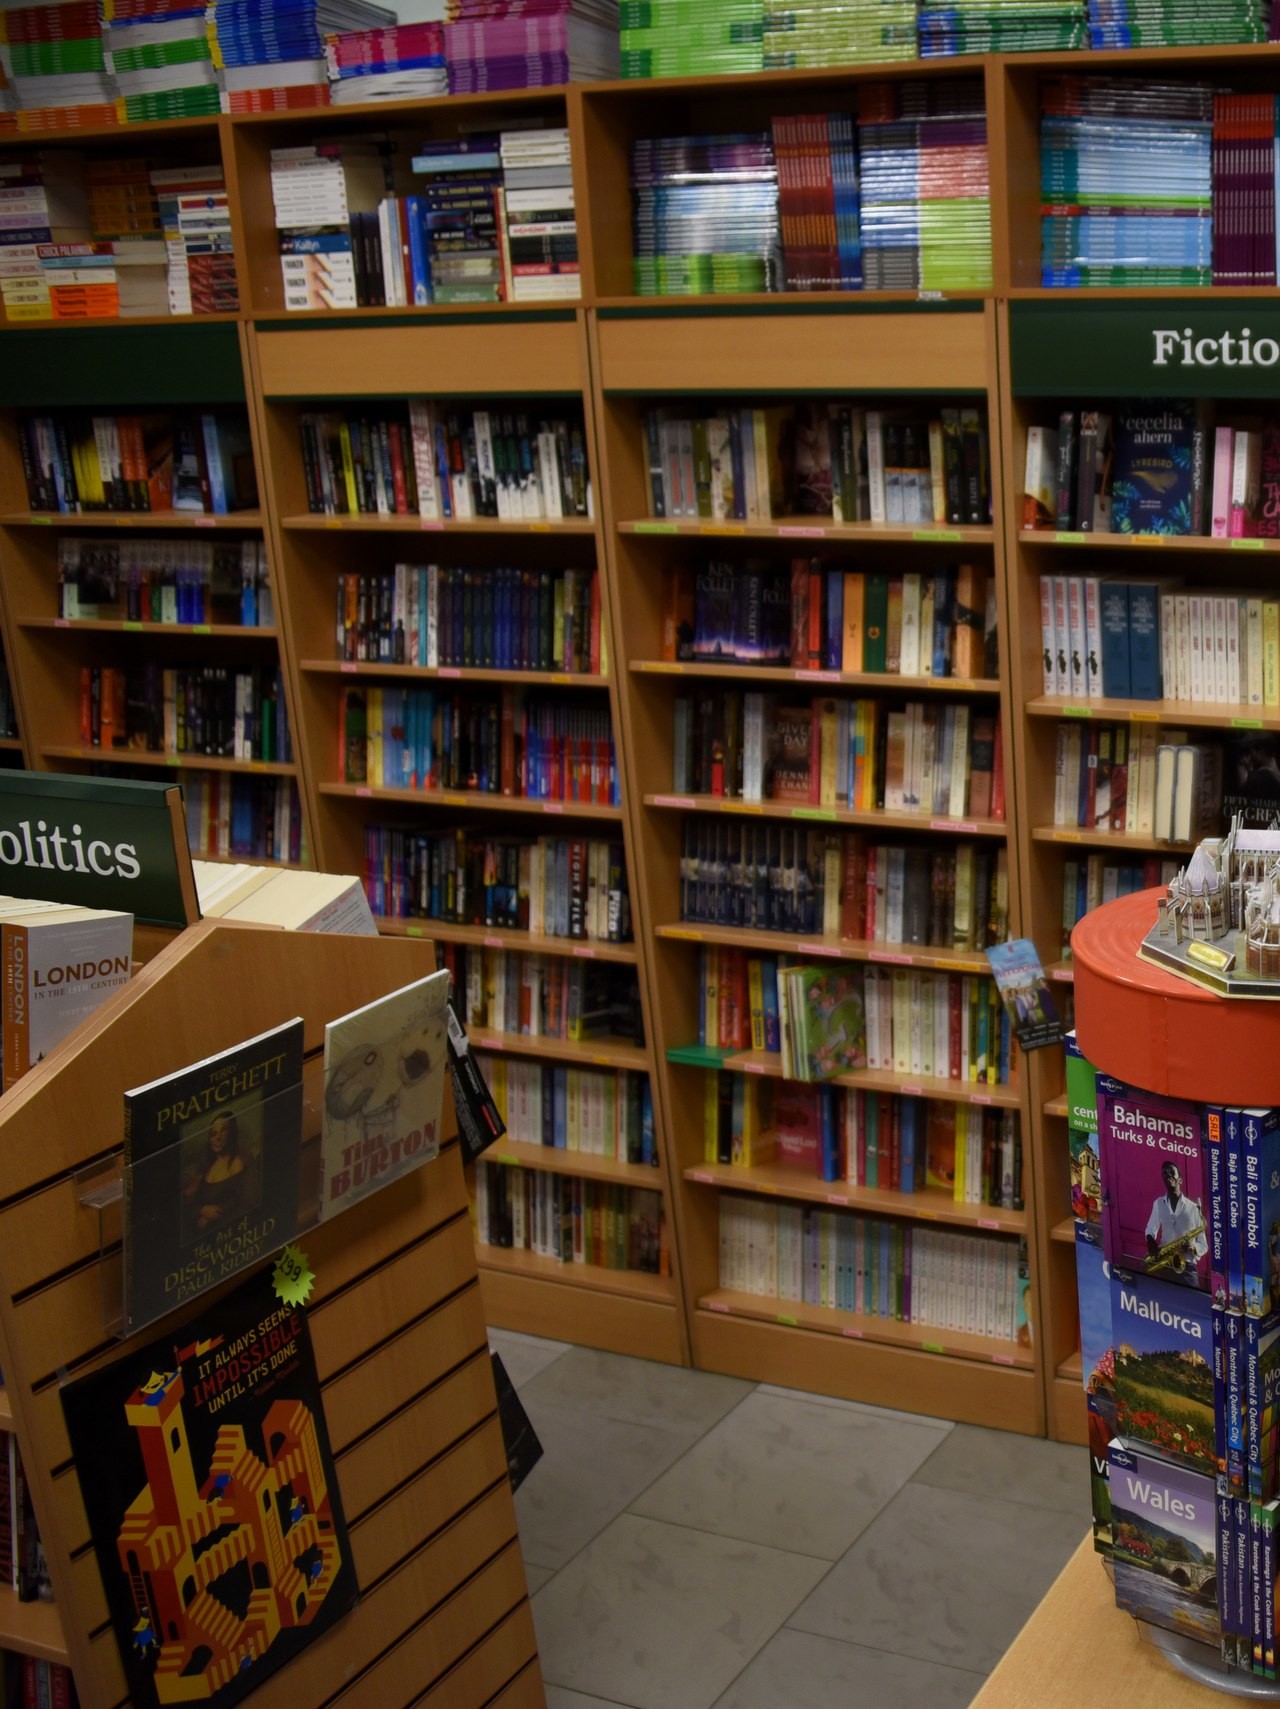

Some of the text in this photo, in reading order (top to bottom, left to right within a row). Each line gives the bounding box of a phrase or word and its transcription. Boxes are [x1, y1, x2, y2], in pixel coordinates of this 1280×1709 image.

[1126, 411, 1184, 431] cecelia
[1133, 430, 1173, 445] ahern
[783, 734, 809, 747] DAY
[13, 934, 25, 1026] LONDON
[34, 955, 130, 988] LONDON
[155, 1052, 288, 1133] PRATCHETT
[1113, 1104, 1194, 1140] Bahamas
[1208, 1115, 1220, 1142] SALE
[1110, 1125, 1143, 1145] Turks
[1158, 1136, 1199, 1158] Caicos
[329, 1118, 438, 1201] BURTON
[1210, 1148, 1220, 1193] Bahamas,
[1228, 1153, 1238, 1174] Baja
[1229, 1184, 1238, 1198] Los
[1246, 1155, 1259, 1250] Bali & Lombok
[1211, 1196, 1221, 1220] Turks
[1230, 1200, 1238, 1228] Cabos
[163, 1217, 277, 1294] DISCWORLD
[1213, 1230, 1222, 1261] Caicos
[176, 1268, 215, 1301] PAUL
[1119, 1290, 1202, 1339] Mallorca
[198, 1305, 294, 1380] IT ALWAYS SEEMS
[191, 1312, 304, 1409] IMPOSSIBLE
[207, 1381, 246, 1415] UNTIL
[246, 1362, 270, 1389] IT'S
[270, 1339, 299, 1371] DONE
[1214, 1346, 1222, 1380] Montréal
[1228, 1346, 1238, 1385] Montréal
[1247, 1353, 1257, 1398] Montréal
[1229, 1394, 1239, 1425] Québec
[1249, 1409, 1258, 1442] Québec
[1231, 1427, 1240, 1444] City
[1249, 1444, 1259, 1463] City
[1126, 1477, 1197, 1521] Wales
